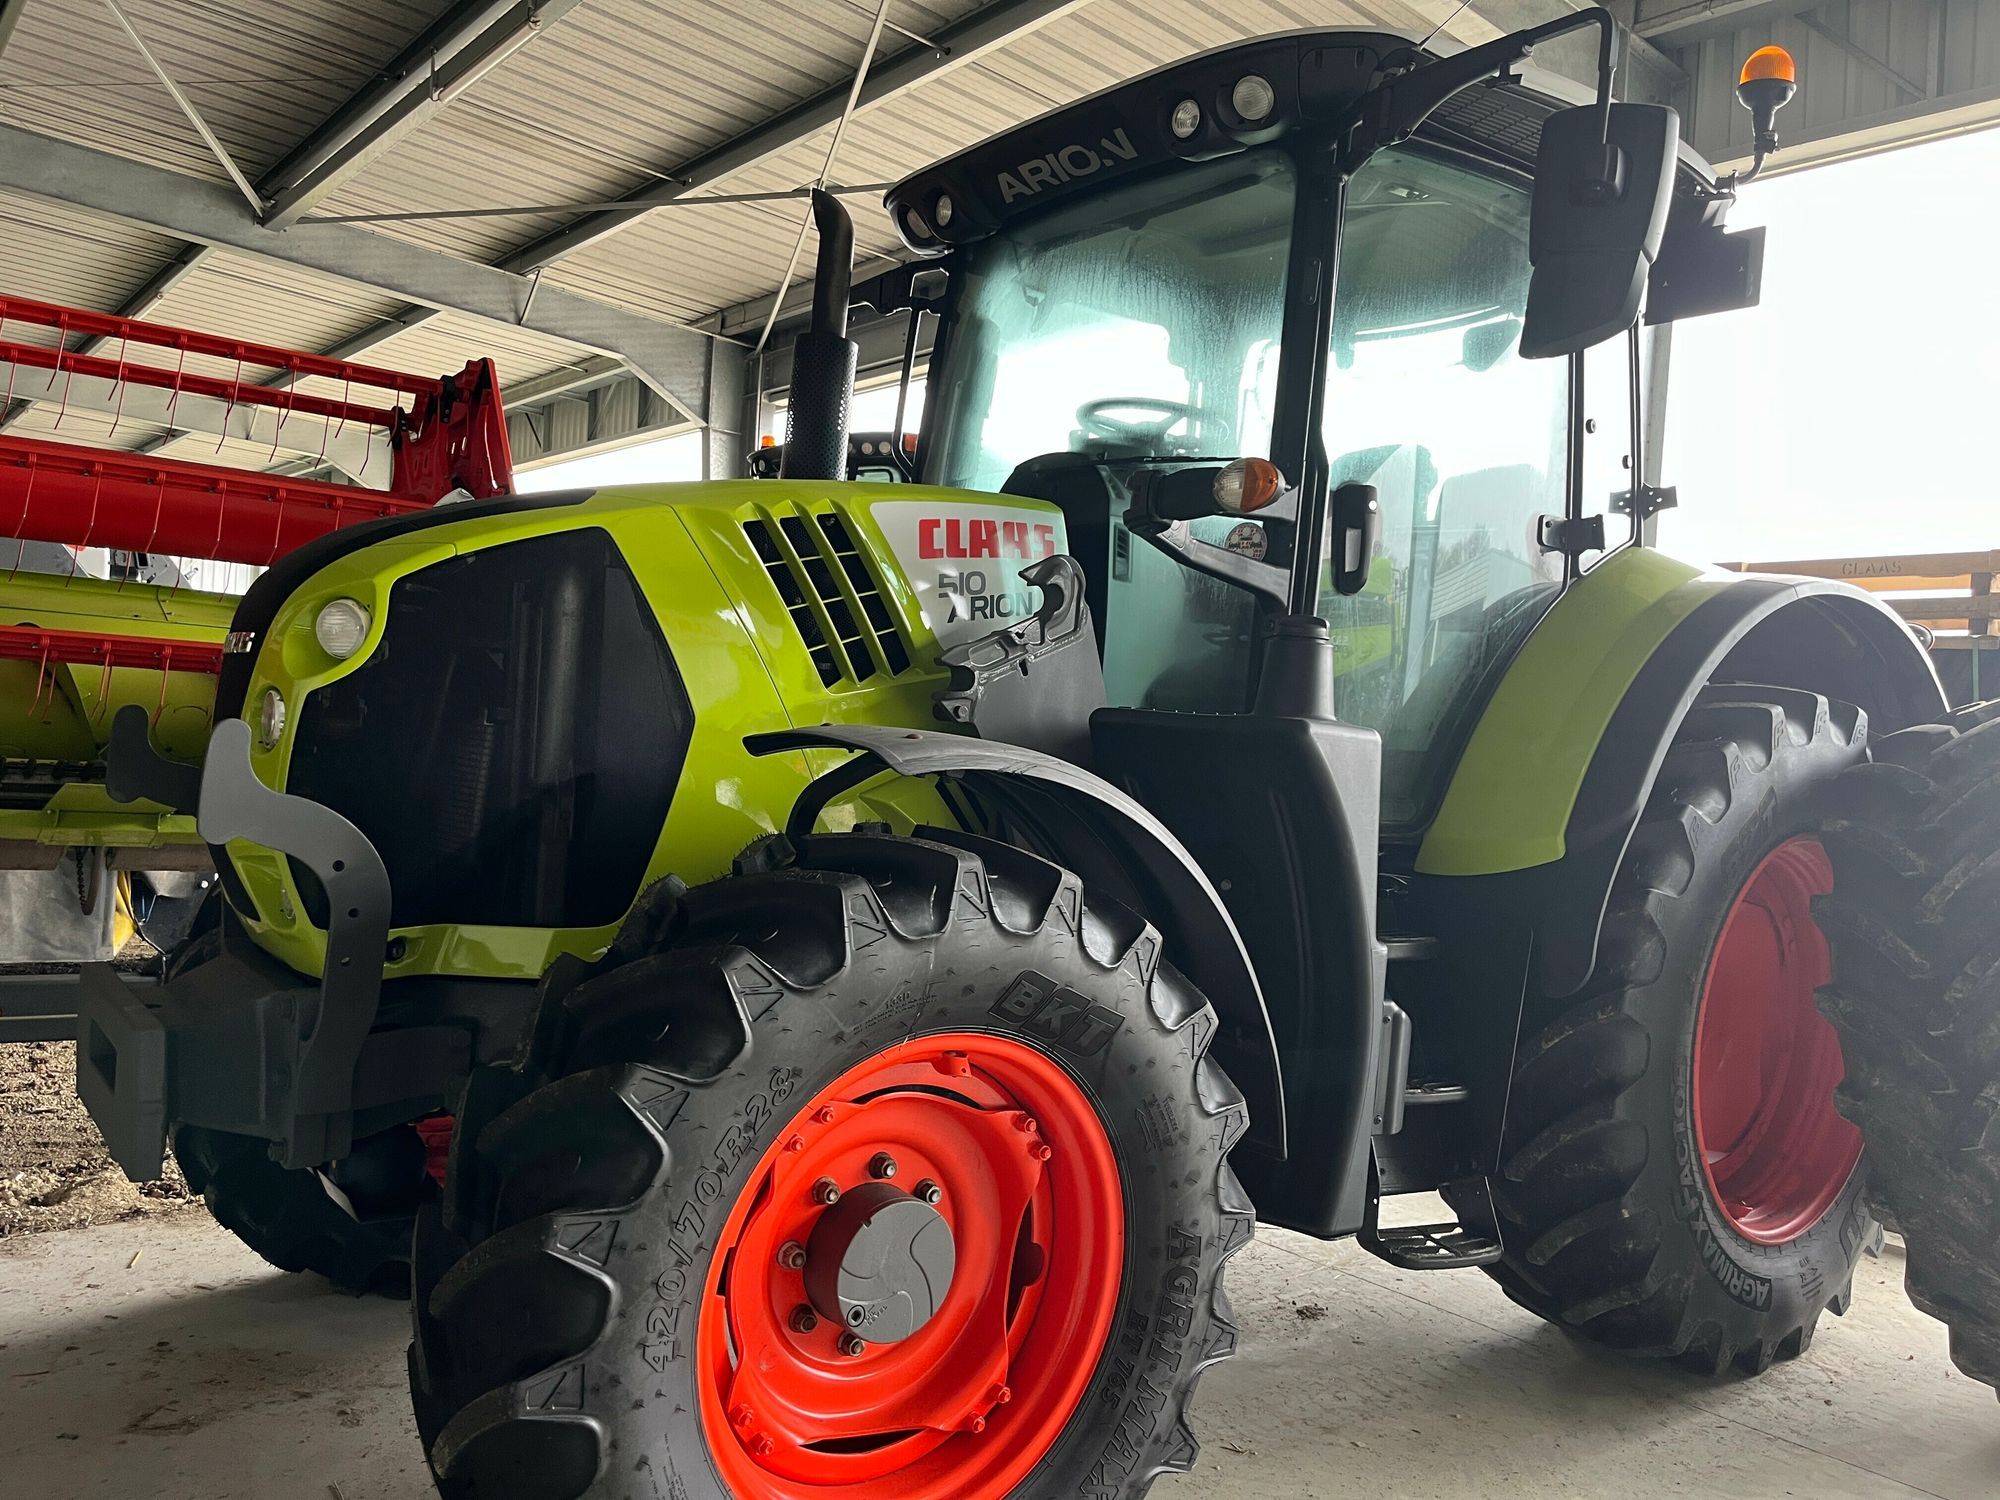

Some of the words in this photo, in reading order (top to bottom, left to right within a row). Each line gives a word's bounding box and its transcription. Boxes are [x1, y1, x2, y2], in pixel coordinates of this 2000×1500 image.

[997, 127, 1139, 204] ARION
[918, 518, 1055, 559] CLAAS
[938, 570, 986, 598] 510
[1841, 560, 1903, 576] CLAAS
[998, 975, 1120, 1054] BKT
[1101, 1357, 1135, 1410] 765
